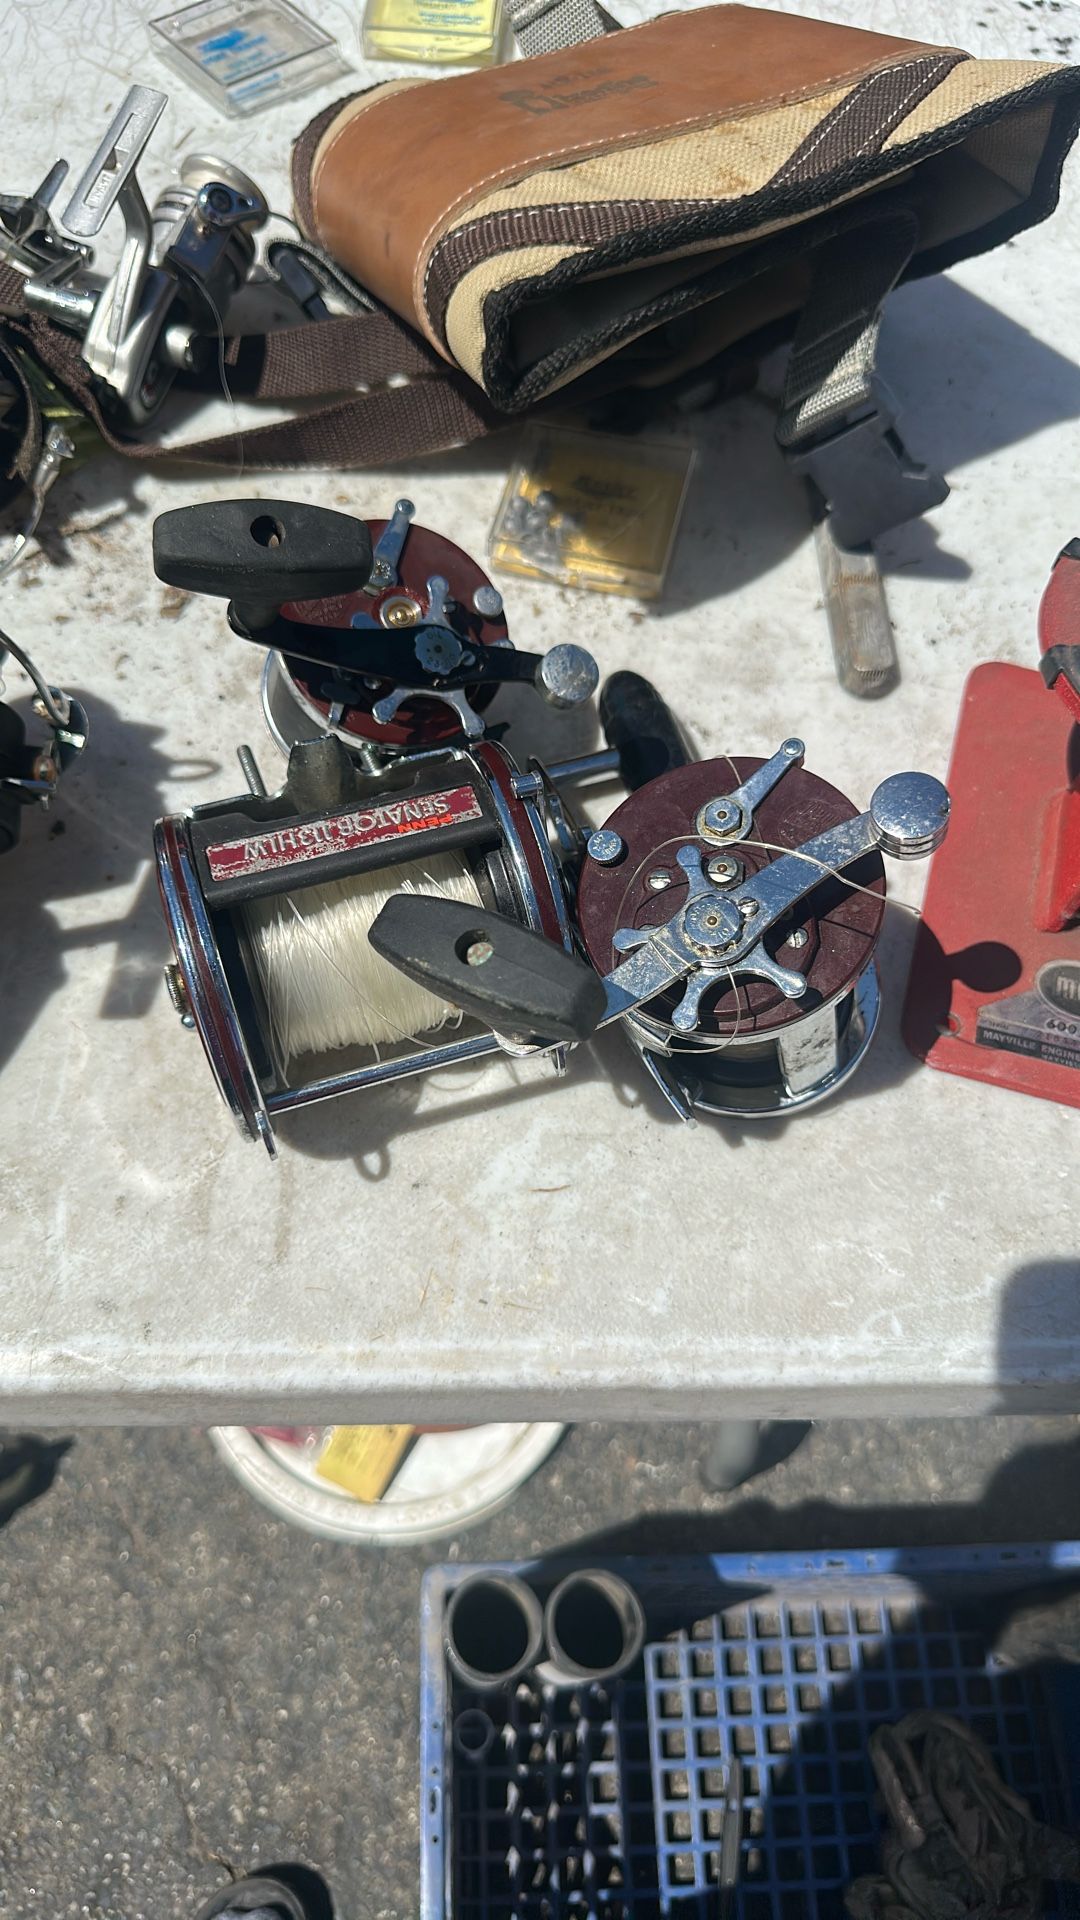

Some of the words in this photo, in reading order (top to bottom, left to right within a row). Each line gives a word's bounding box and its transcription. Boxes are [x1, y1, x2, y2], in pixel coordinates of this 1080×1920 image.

[339, 796, 451, 836] SENATOR
[397, 814, 453, 833] PENN
[1046, 1019, 1077, 1034] 600
[983, 1030, 1036, 1050] MAYVILLE
